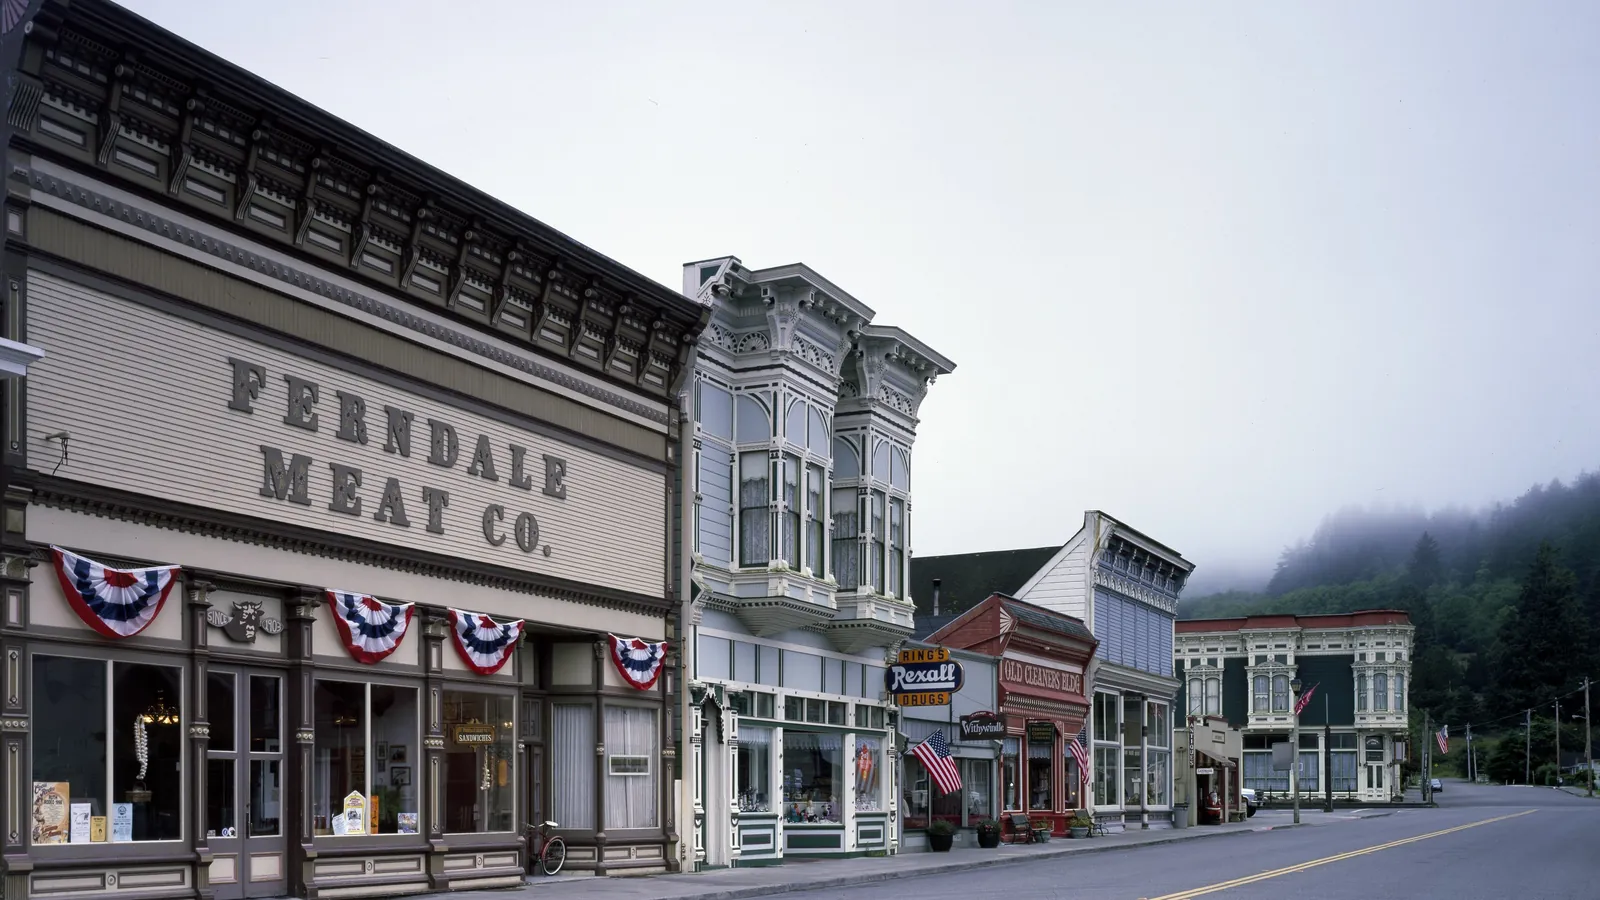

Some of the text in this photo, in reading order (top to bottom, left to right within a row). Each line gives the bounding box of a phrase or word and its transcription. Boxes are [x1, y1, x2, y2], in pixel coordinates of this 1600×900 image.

[228, 357, 568, 498] FERNDALE
[259, 444, 552, 557] MEAT CO.
[207, 611, 227, 625] SINCE
[265, 620, 281, 633] 1903
[902, 649, 945, 661] RING'S
[892, 664, 955, 690] Rexall
[1004, 660, 1080, 693] OLD CLEANERS BLDG
[903, 692, 944, 705] DRUGS
[962, 720, 1004, 735] Withywindle
